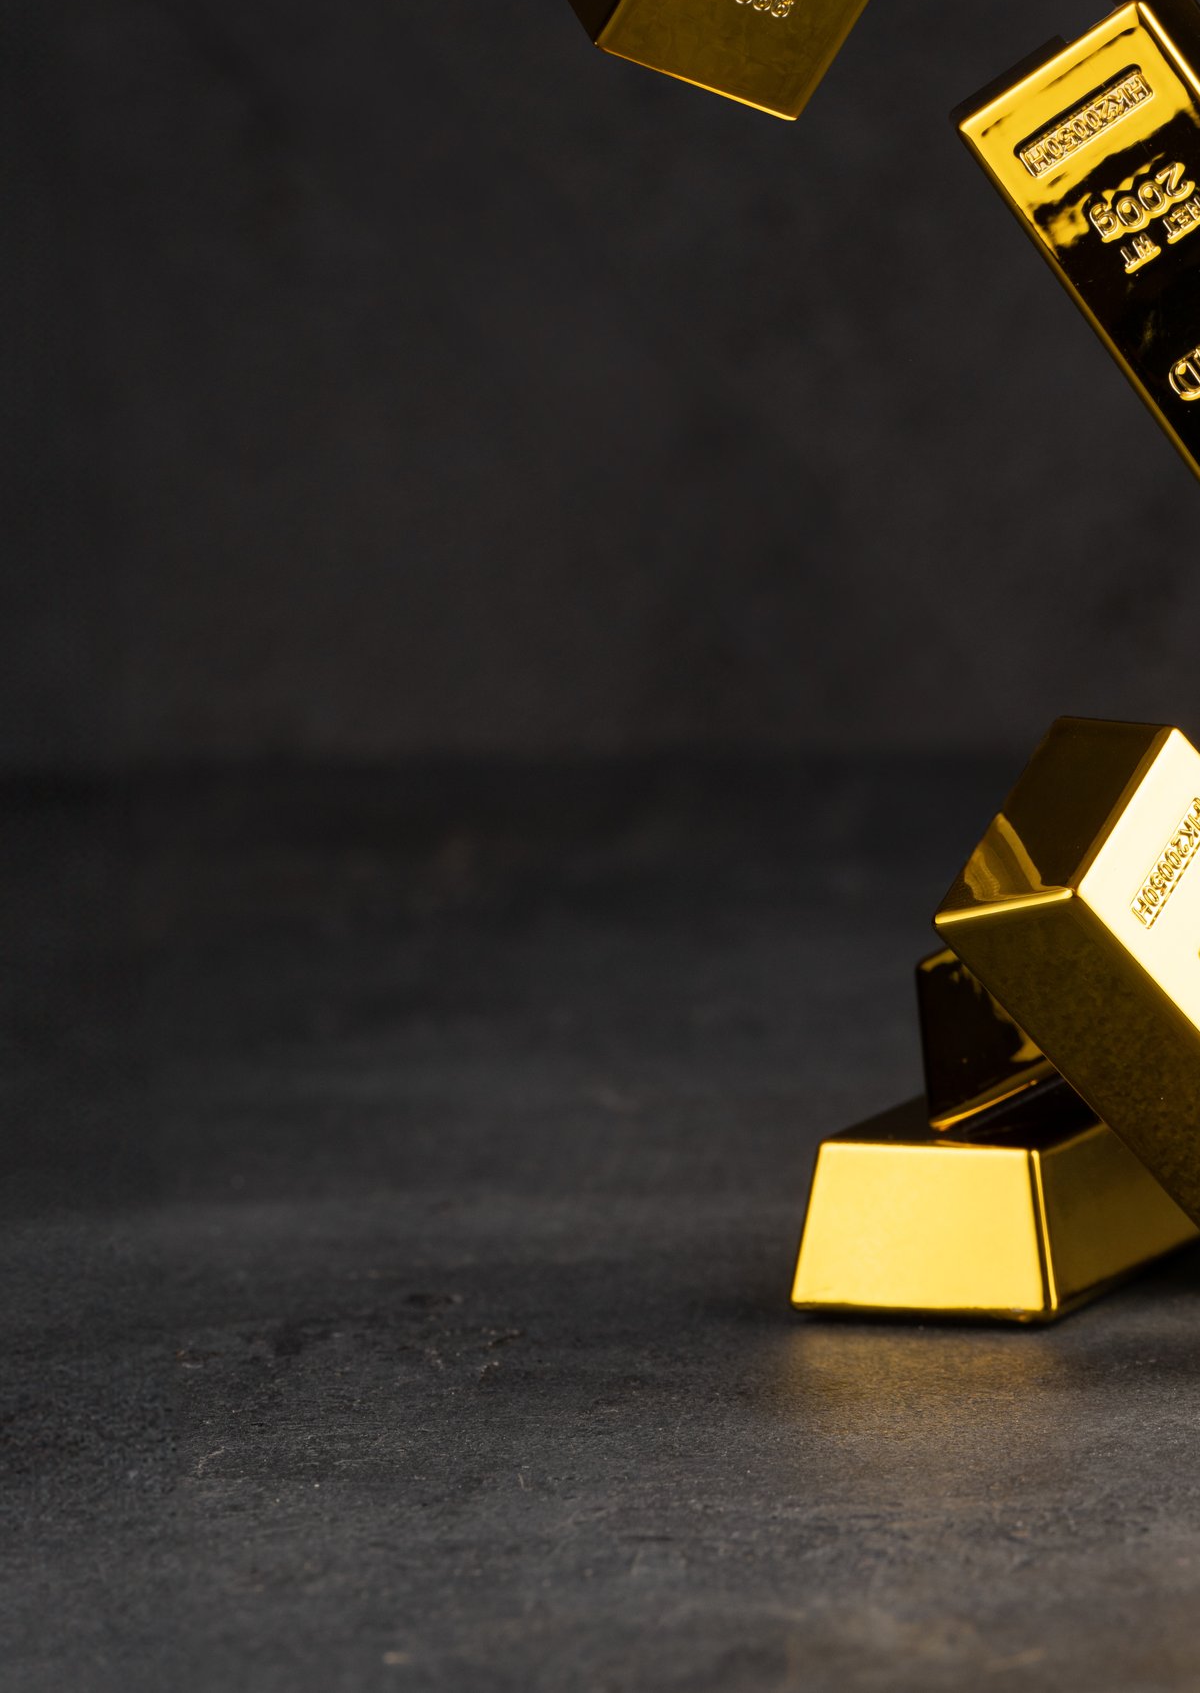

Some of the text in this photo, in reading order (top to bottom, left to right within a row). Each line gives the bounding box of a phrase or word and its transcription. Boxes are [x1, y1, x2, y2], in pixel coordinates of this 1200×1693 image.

[1024, 75, 1149, 173] HK20050H
[1089, 161, 1194, 243] 200g
[1119, 232, 1161, 273] WT
